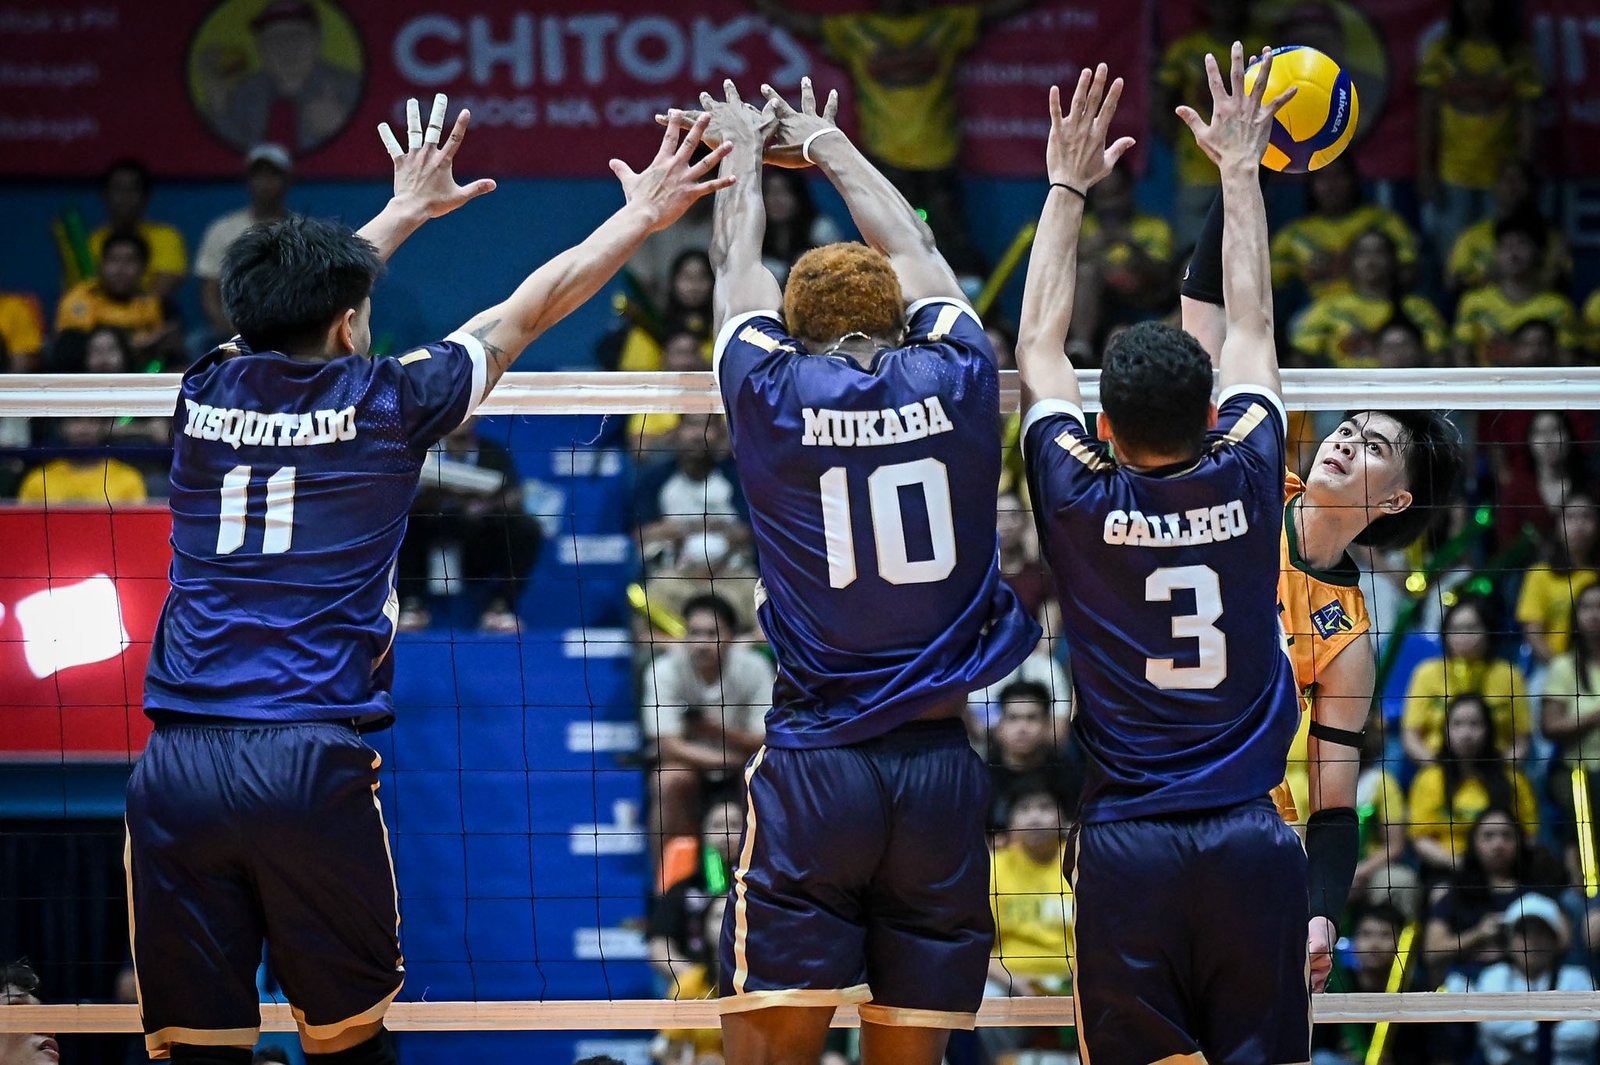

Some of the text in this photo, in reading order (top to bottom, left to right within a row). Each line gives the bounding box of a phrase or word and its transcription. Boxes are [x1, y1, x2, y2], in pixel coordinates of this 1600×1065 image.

[802, 396, 954, 447] MUKABA
[216, 465, 297, 555] 11
[820, 457, 957, 589] 10
[1103, 500, 1249, 547] GALLEGO
[1145, 564, 1228, 690] 3
